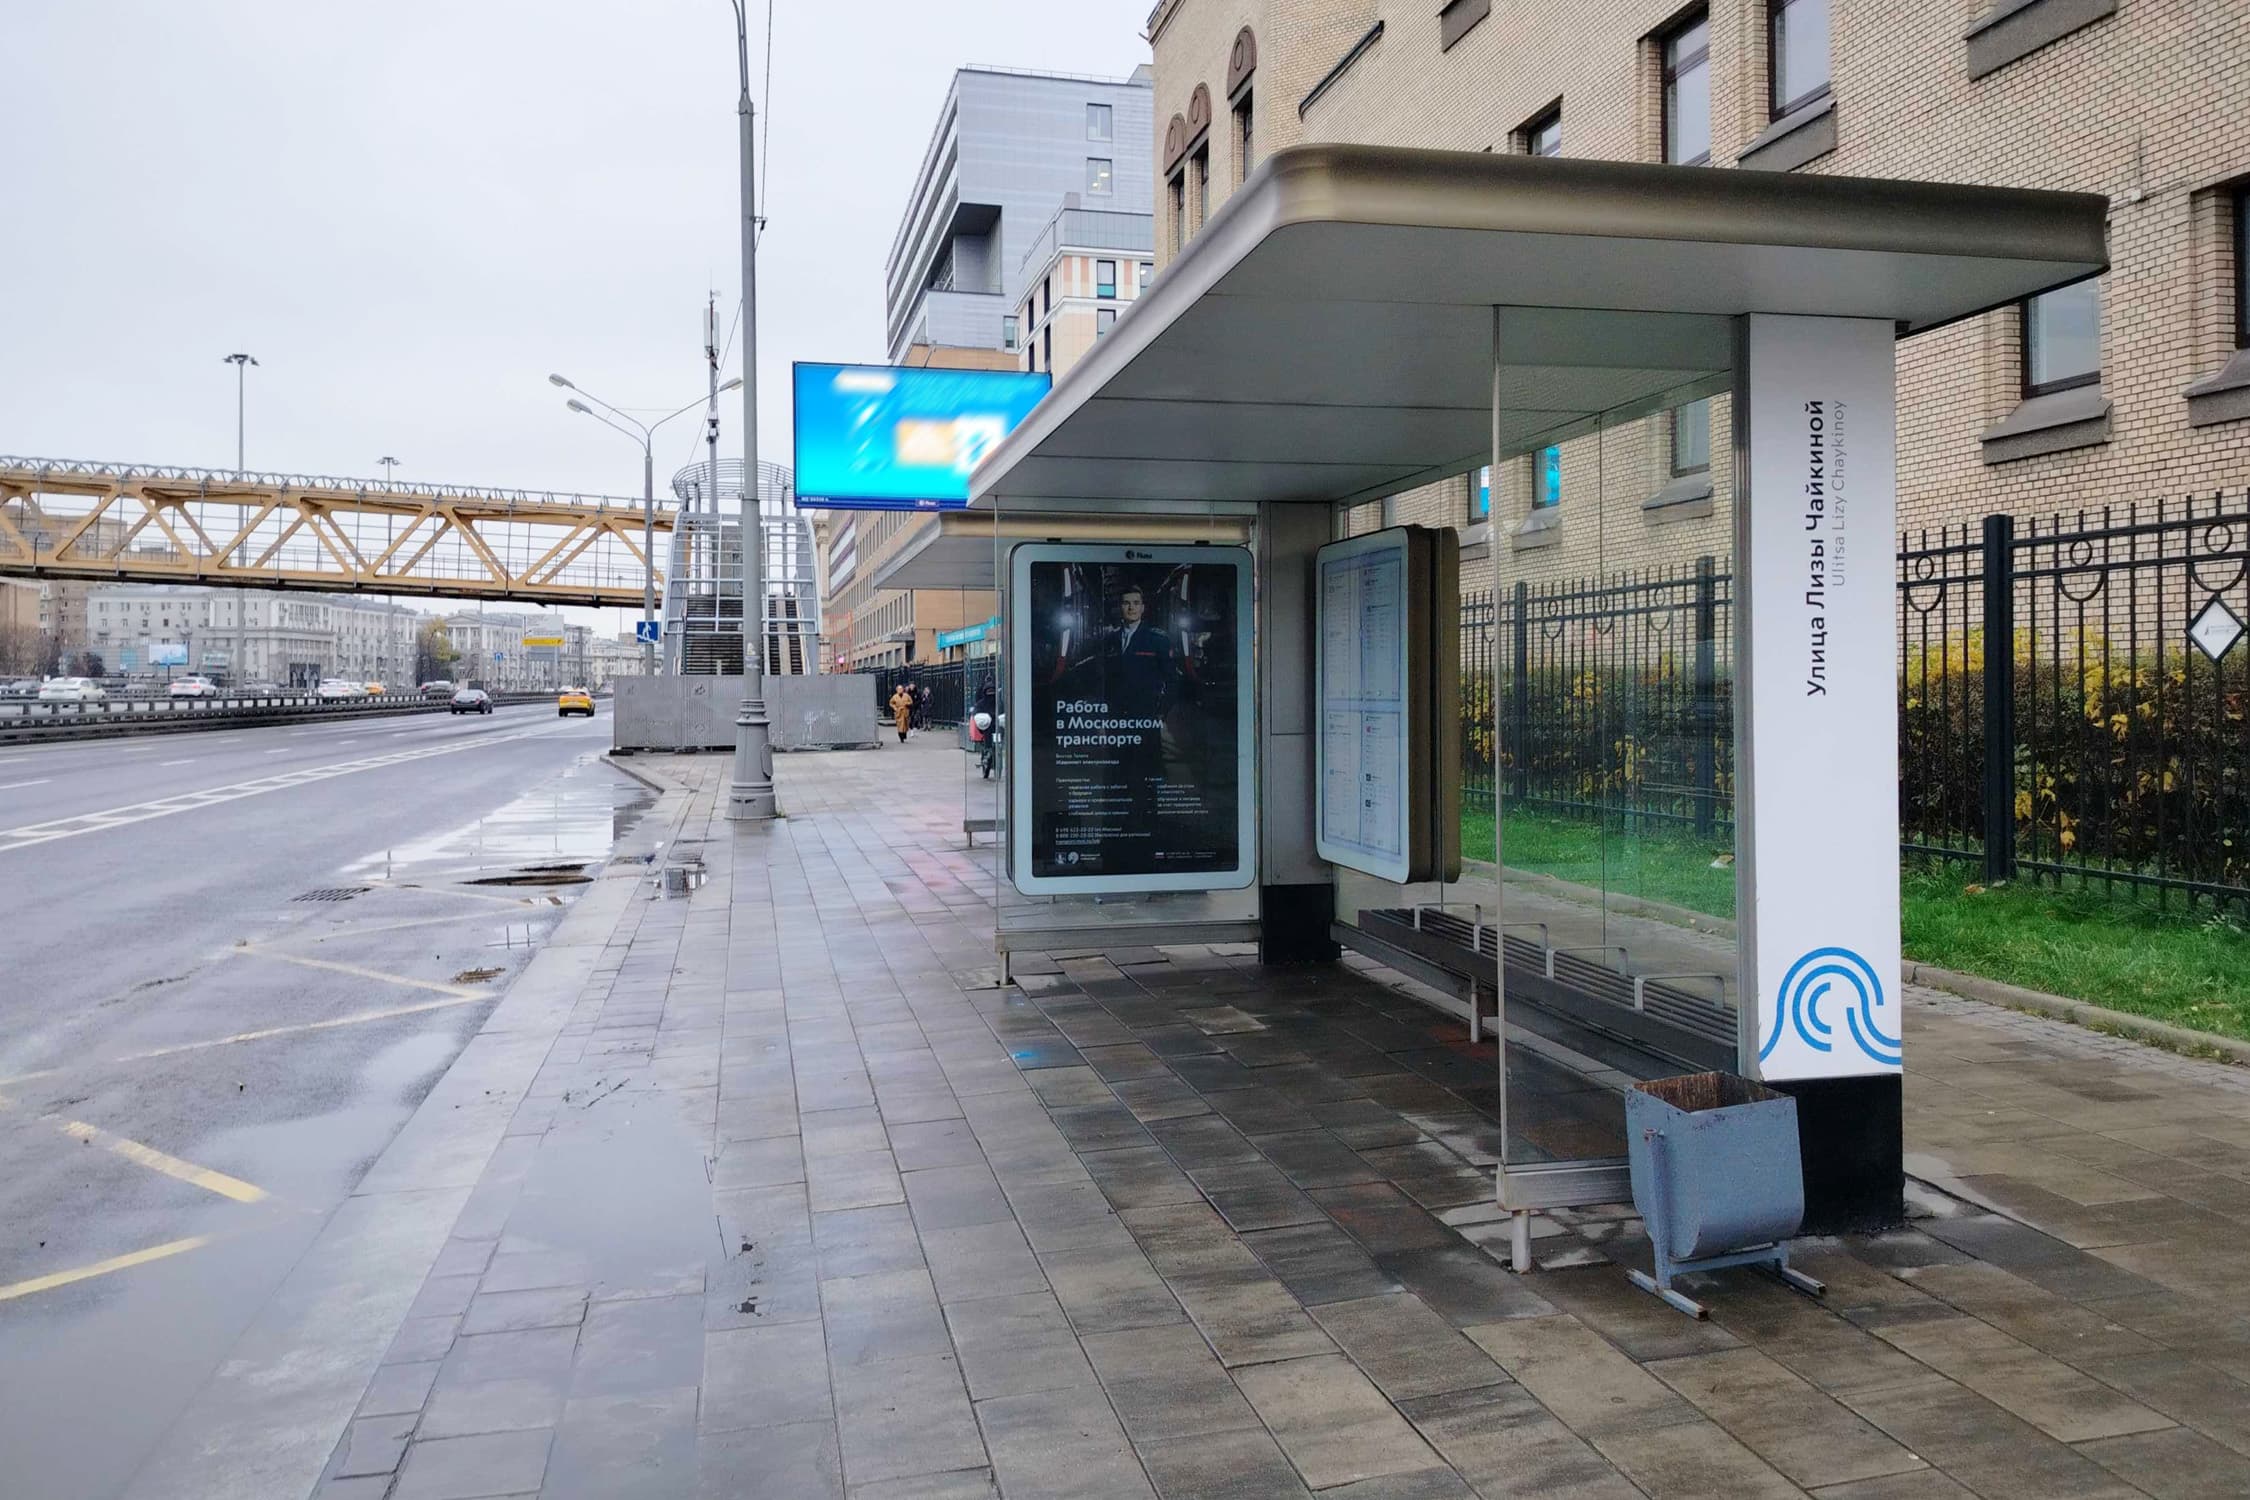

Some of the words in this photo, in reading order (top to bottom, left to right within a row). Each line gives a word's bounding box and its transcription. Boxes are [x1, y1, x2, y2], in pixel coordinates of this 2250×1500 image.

[1804, 400, 1824, 531] Чайкиной
[1830, 400, 1847, 491] Chaykinoy
[1831, 495, 1847, 530] Lizy
[1805, 539, 1825, 609] Лизы
[1831, 536, 1846, 586] Ulitsa
[1806, 616, 1828, 697] Улица
[1056, 699, 1109, 714] Работа
[1056, 719, 1065, 730] в
[1067, 716, 1165, 730] Московском
[1055, 735, 1143, 749] транспорте
